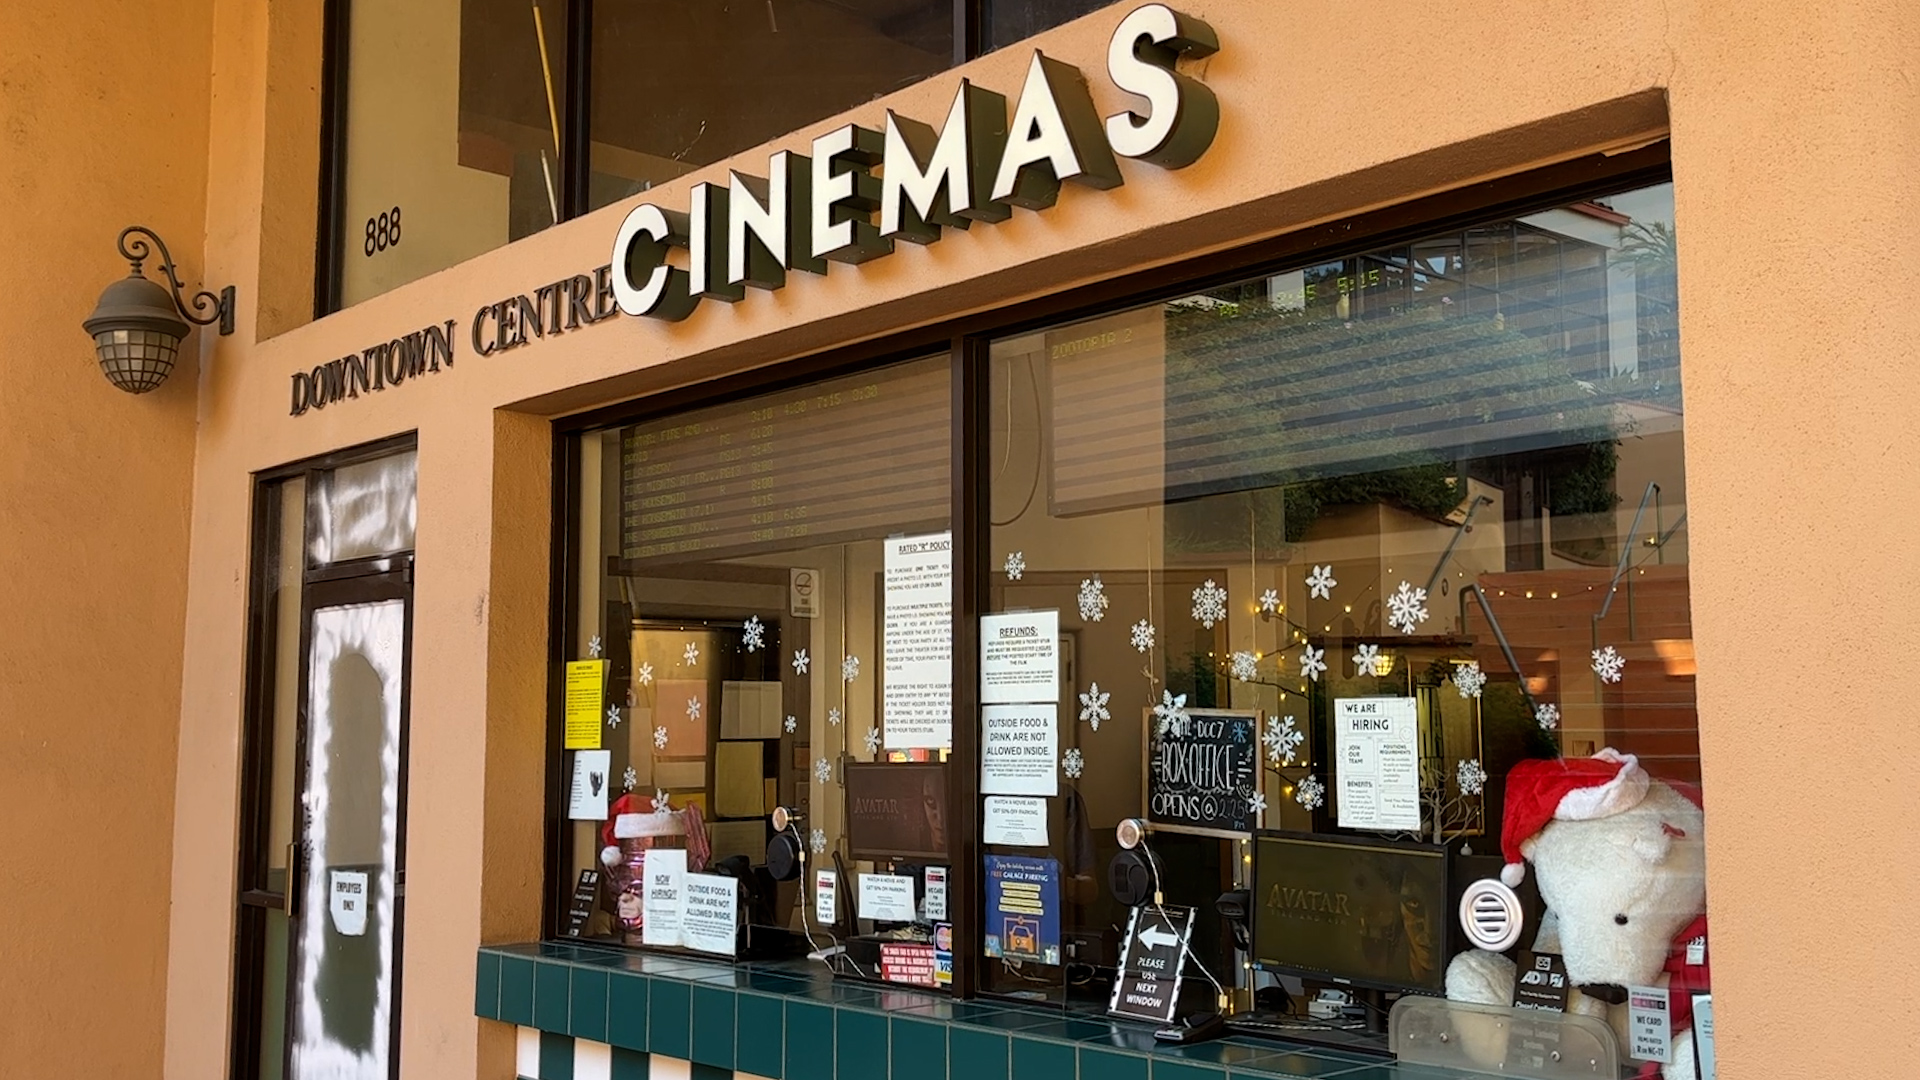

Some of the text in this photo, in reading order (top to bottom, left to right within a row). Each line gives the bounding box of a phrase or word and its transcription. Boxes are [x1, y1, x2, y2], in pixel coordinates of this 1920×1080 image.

[612, 3, 1190, 320] CINEMAS
[364, 206, 400, 257] 888
[1337, 269, 1380, 294] 5:15
[289, 264, 620, 417] DOWNTOWN CENTRE
[1051, 328, 1133, 360] ZOOTOPIA 2
[817, 393, 841, 408] 7:15
[899, 543, 917, 555] RATED
[930, 540, 950, 552] POLICY
[1000, 626, 1038, 638] REFUNDS:
[1345, 703, 1376, 713] WE ARE
[989, 718, 1048, 728] OUTSIDE FOOD &
[1352, 719, 1389, 731] HIRING
[1198, 720, 1225, 739] DCC7
[990, 732, 1046, 742] DRINK ARE NOT
[986, 746, 1050, 755] ALLOWED INSIDE.
[1162, 742, 1234, 790] BOX OFFICE
[854, 797, 900, 814] AVATAR
[1152, 793, 1200, 820] OPENS
[1201, 795, 1218, 820] @
[655, 875, 670, 885] NOW
[1003, 871, 1023, 879] GARAGE
[1024, 873, 1048, 882] PARKING
[687, 884, 709, 894] OUTSIDE
[711, 886, 726, 896] FOOD
[689, 896, 730, 908] DRINK ARE NOT
[1266, 883, 1351, 916] AVATAR
[686, 908, 712, 918] ALLOWED
[940, 961, 952, 973] VIS
[1137, 957, 1165, 969] PLEASE
[1142, 971, 1157, 980] USE
[1136, 982, 1157, 994] NEXT
[1126, 994, 1162, 1008] WINDOW
[1636, 1015, 1662, 1026] WE CARD
